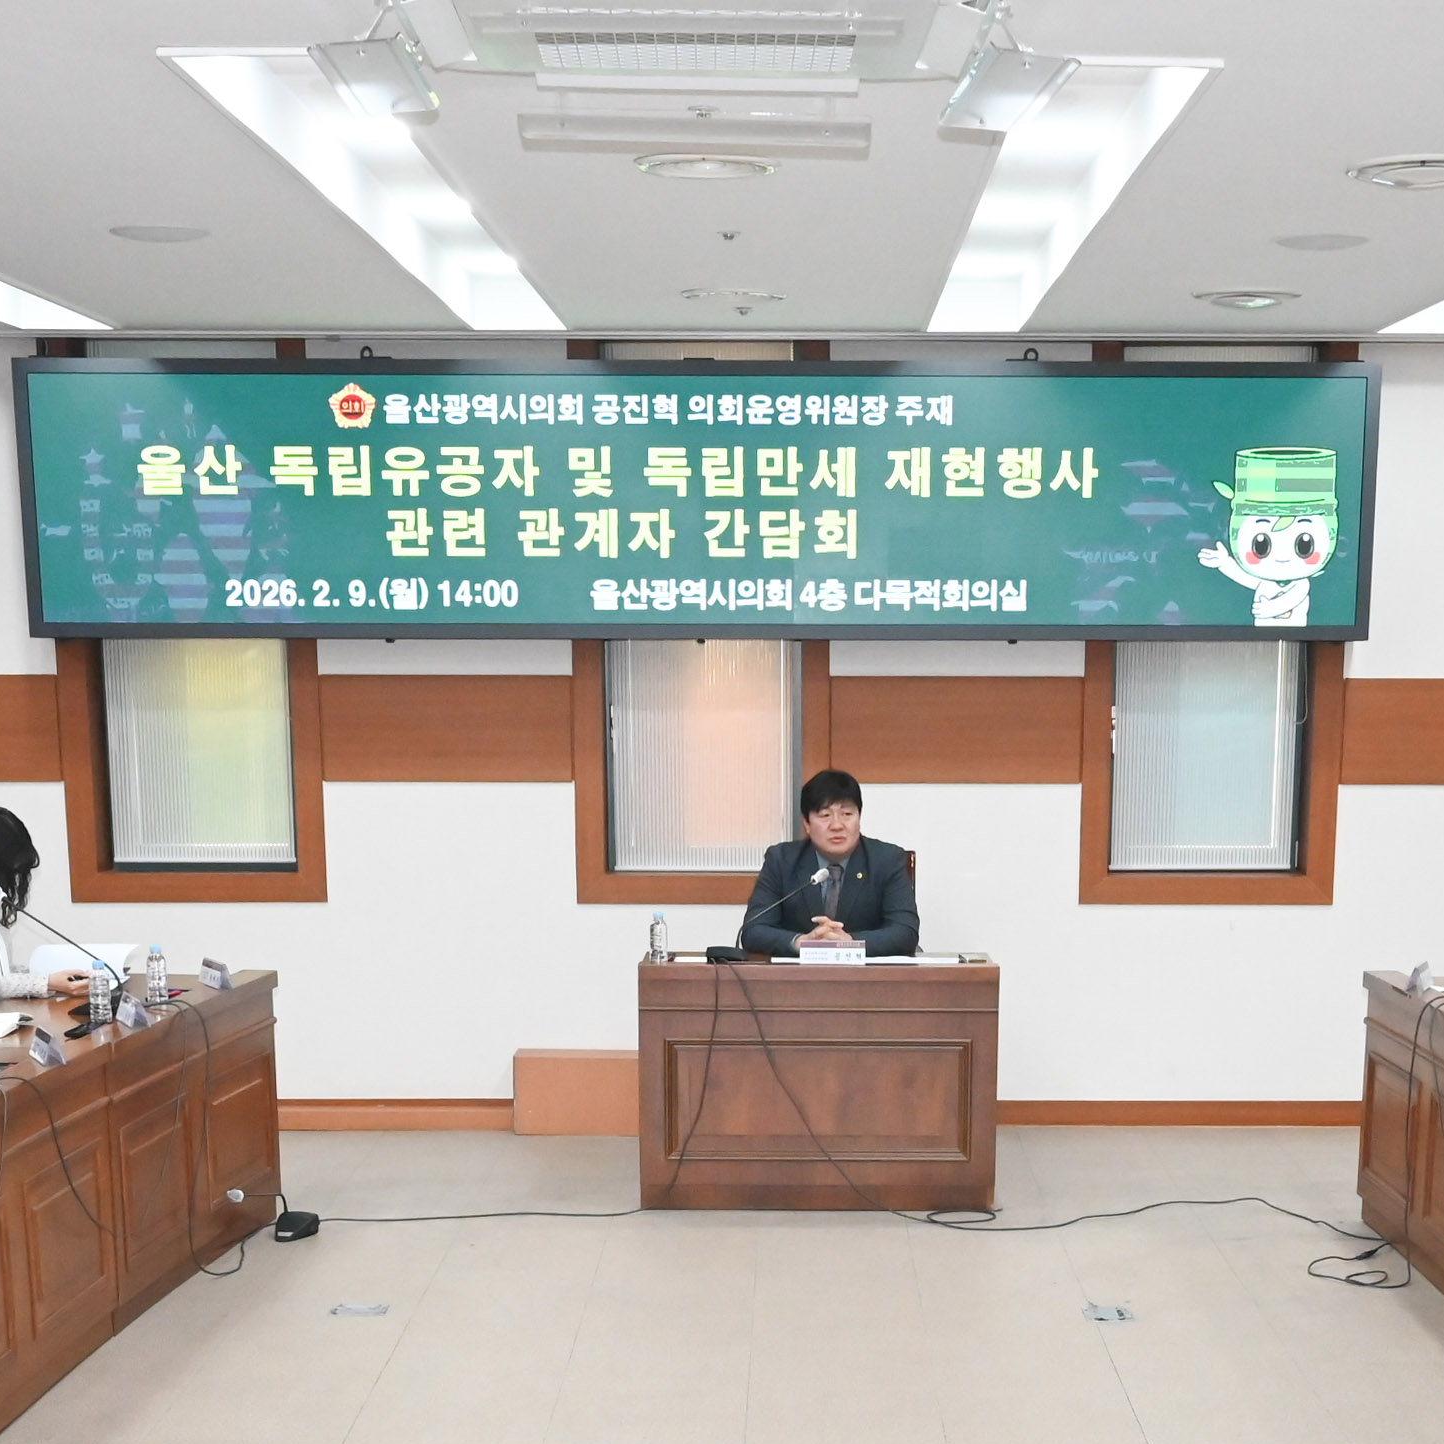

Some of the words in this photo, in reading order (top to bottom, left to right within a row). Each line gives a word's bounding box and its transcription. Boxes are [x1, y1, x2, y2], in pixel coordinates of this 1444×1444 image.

[341, 400, 365, 413] 의회
[383, 393, 584, 425] 울산광역시의회
[591, 394, 678, 425] 공진혁
[687, 394, 889, 426] 의회운영위원장
[895, 395, 953, 426] 주재
[137, 444, 242, 495] 울산
[269, 445, 540, 497] 독립유공자
[568, 445, 613, 498] 및
[643, 446, 856, 498] 독립만세
[884, 446, 1099, 499] 재현행사
[386, 507, 486, 557] 관련
[517, 508, 676, 559] 관계자
[704, 508, 857, 559] 간담회
[225, 579, 305, 607] 2026.
[312, 579, 340, 607] 2.
[437, 579, 519, 607] 14:00
[590, 578, 792, 611] 울산광역시의회
[799, 578, 848, 612] 4층
[854, 579, 1027, 612] 다목적회의실
